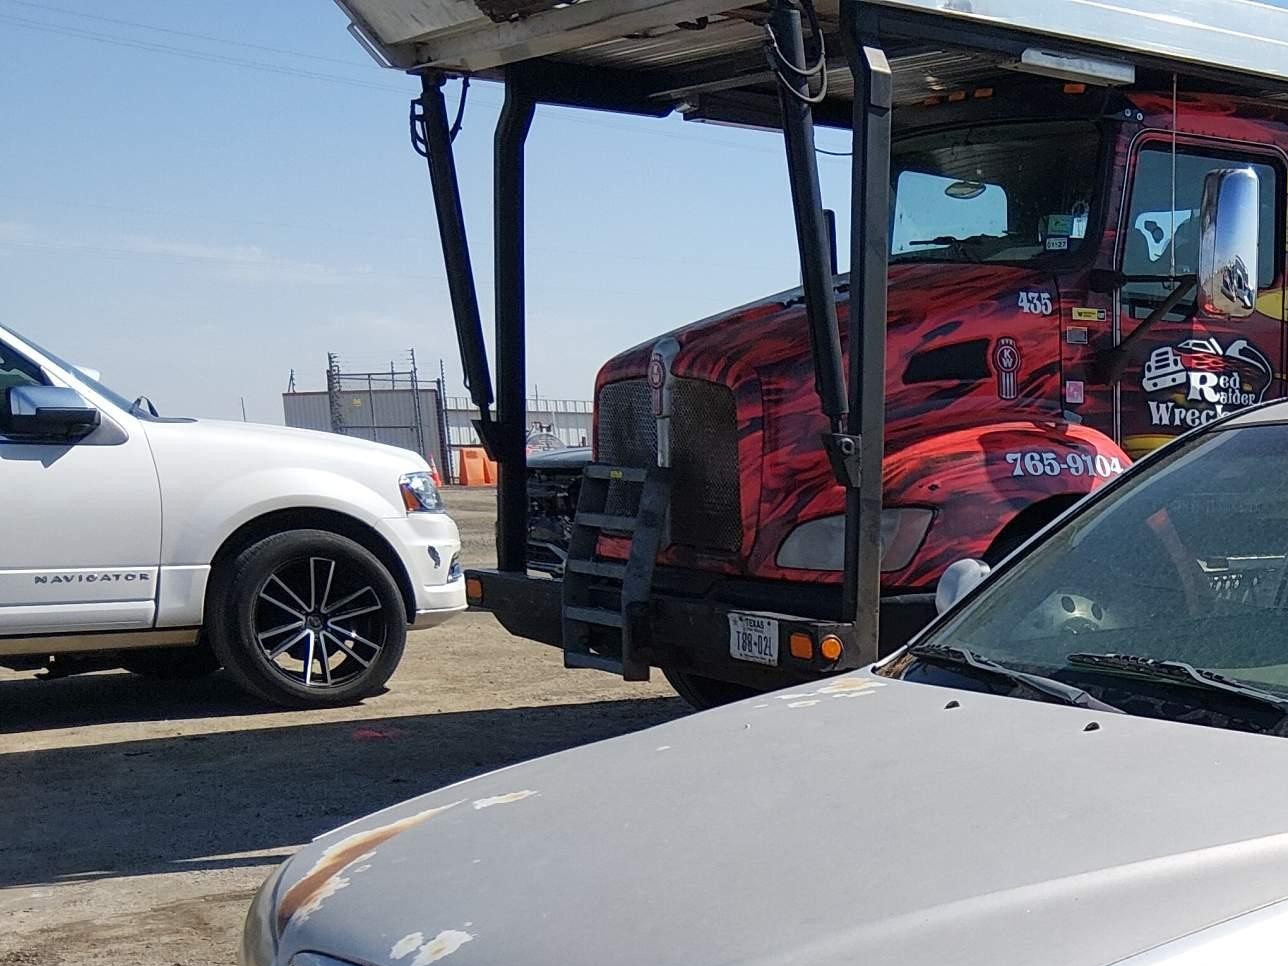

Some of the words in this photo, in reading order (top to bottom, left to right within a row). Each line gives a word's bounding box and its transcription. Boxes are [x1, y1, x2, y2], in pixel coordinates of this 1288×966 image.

[1018, 291, 1053, 315] 435
[1005, 452, 1124, 477] 765-9104
[34, 573, 150, 584] NAVIGATOR
